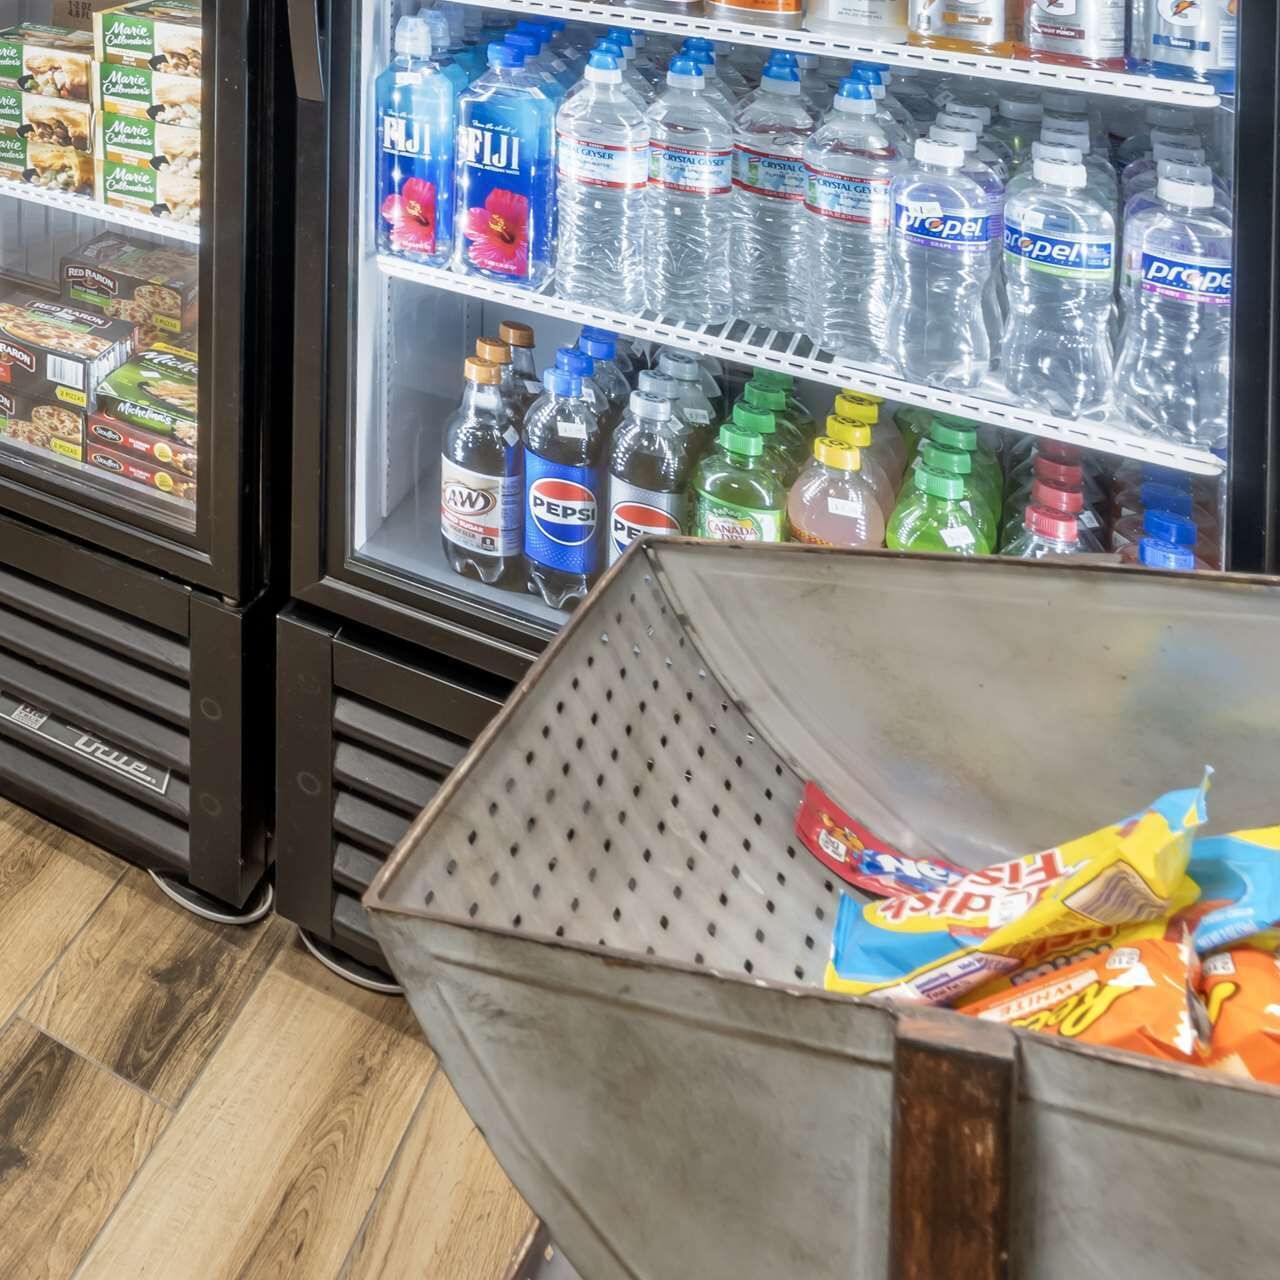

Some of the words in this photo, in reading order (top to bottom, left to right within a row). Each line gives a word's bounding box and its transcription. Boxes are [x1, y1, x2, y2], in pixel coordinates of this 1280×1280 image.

[106, 21, 149, 36] Marie
[105, 34, 153, 46] Callender's
[103, 71, 146, 85] Marie
[102, 82, 151, 96] Callender's
[105, 120, 149, 136] Marie
[383, 116, 432, 155] FIJI
[105, 132, 153, 146] Callender's
[466, 126, 521, 170] FIJI
[662, 151, 696, 166] CRYSTAL
[761, 160, 799, 173] CRYSTAL
[108, 168, 152, 184] Marie
[106, 181, 154, 194] Callender's
[900, 210, 983, 238] propel
[1004, 232, 1082, 263] propel
[68, 267, 85, 277] RED
[85, 270, 114, 289] BARON
[1146, 261, 1232, 290] prope
[33, 302, 60, 313] RED
[60, 306, 105, 326] BARON
[0, 342, 31, 366] BARON
[117, 400, 173, 425] Michelina's
[533, 495, 597, 521] PEPSI
[708, 519, 759, 537] CANADA
[67, 725, 157, 784] true
